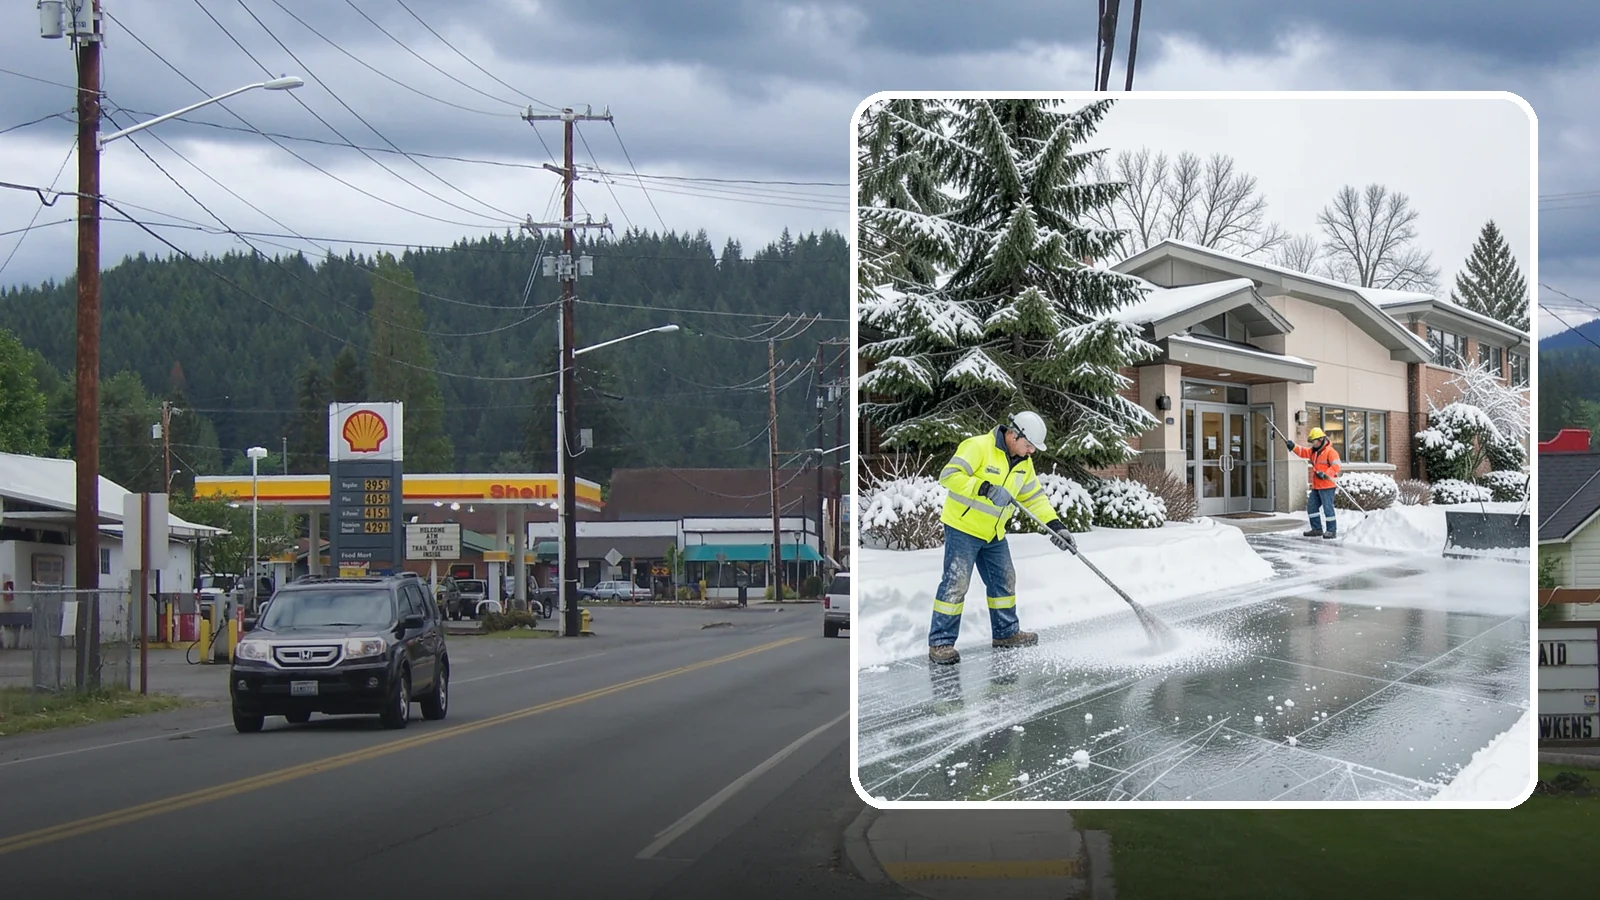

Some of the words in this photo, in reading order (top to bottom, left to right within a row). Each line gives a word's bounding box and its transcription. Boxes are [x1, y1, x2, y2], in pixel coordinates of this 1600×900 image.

[366, 480, 383, 490] 395
[490, 484, 547, 499] Shell
[366, 494, 383, 504] 405
[366, 508, 383, 518] 415
[366, 522, 383, 532] 429
